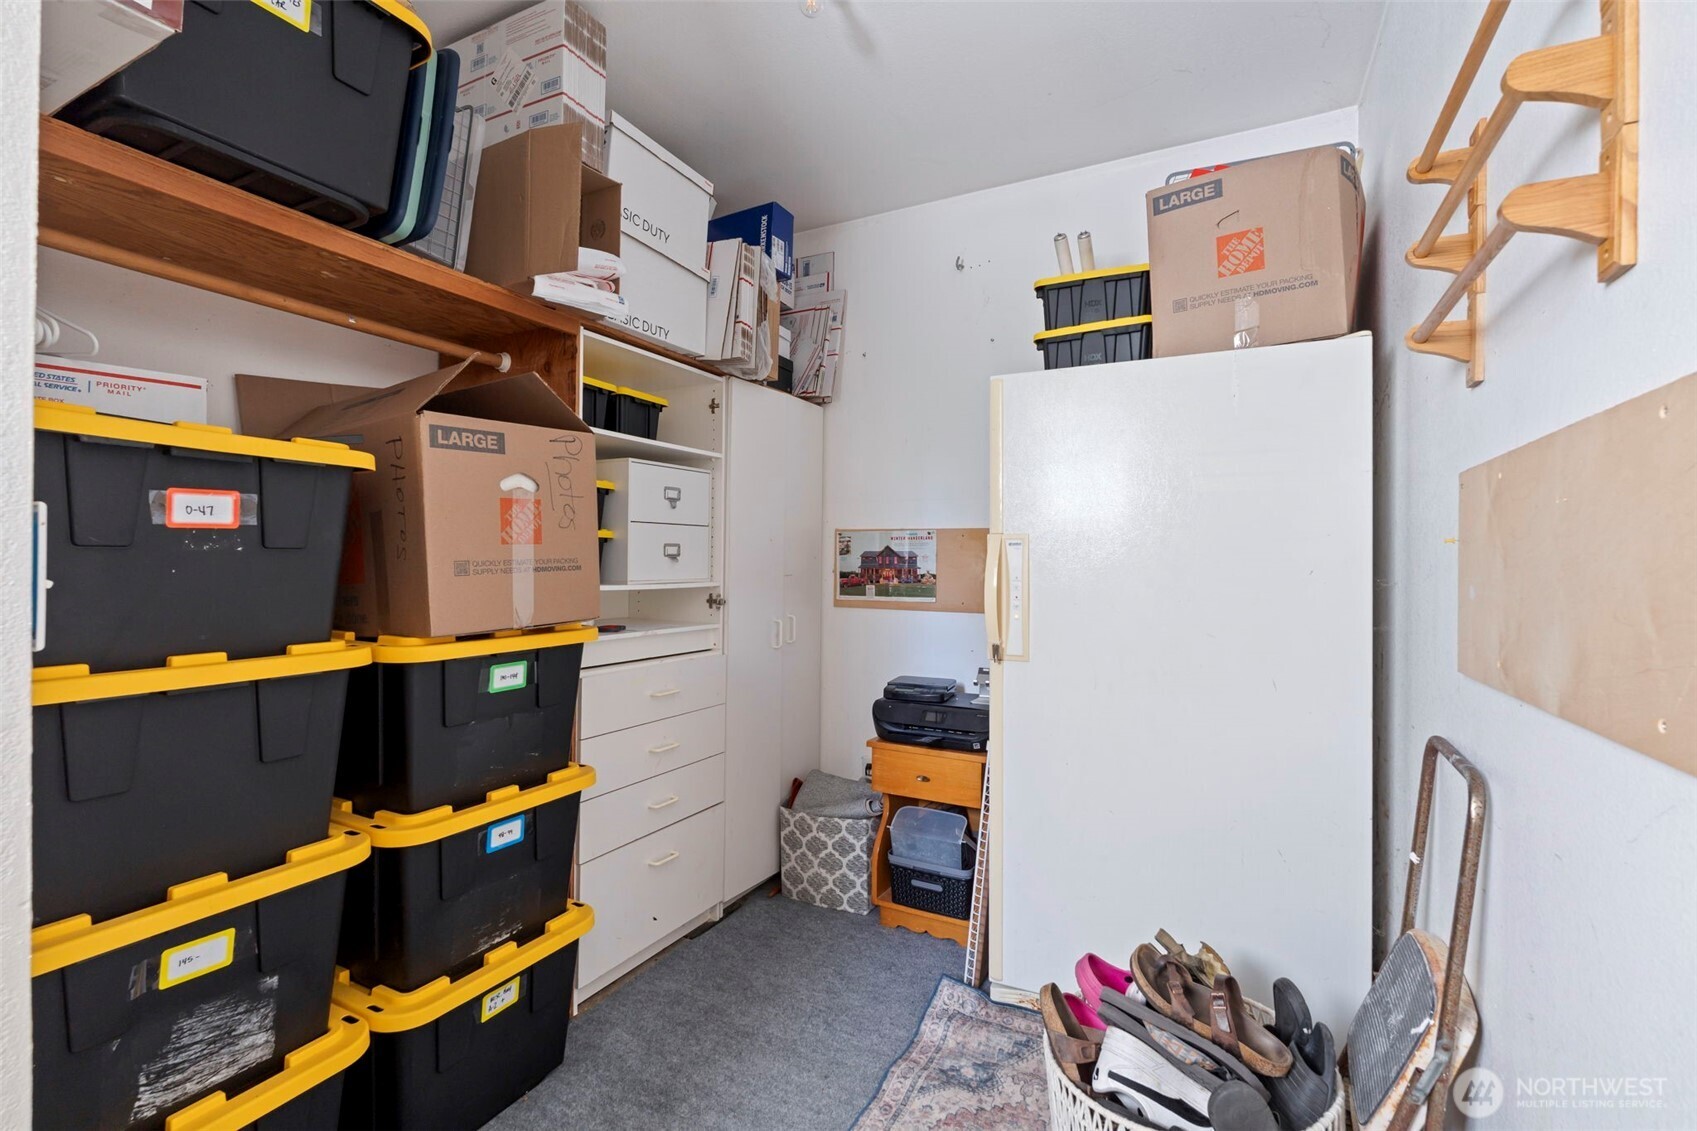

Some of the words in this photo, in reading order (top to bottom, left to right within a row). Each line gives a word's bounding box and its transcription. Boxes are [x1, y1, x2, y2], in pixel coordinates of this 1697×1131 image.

[1159, 183, 1216, 211] LARGE
[642, 218, 670, 243] DUTY
[1218, 230, 1263, 276] HOME
[1222, 236, 1241, 257] THE
[1236, 242, 1264, 274] DEPOT
[1189, 291, 1220, 303] QUICKLY
[1220, 285, 1255, 297] ESTIMATE
[1255, 280, 1278, 291] YOUR
[1279, 274, 1314, 285] PACKING
[1189, 299, 1217, 310] SUPPLY
[1253, 280, 1319, 298] HDMOVING.COM
[642, 320, 670, 340] DUTY
[46, 373, 76, 383] STATES
[107, 389, 132, 397] MAIL
[437, 429, 498, 449] LARGE
[185, 505, 214, 516] 0-47
[472, 559, 501, 567] QUICKLY
[534, 558, 552, 566] YOUR
[472, 567, 498, 576] SUPPLY
[533, 564, 582, 573] HDMOVING.COM
